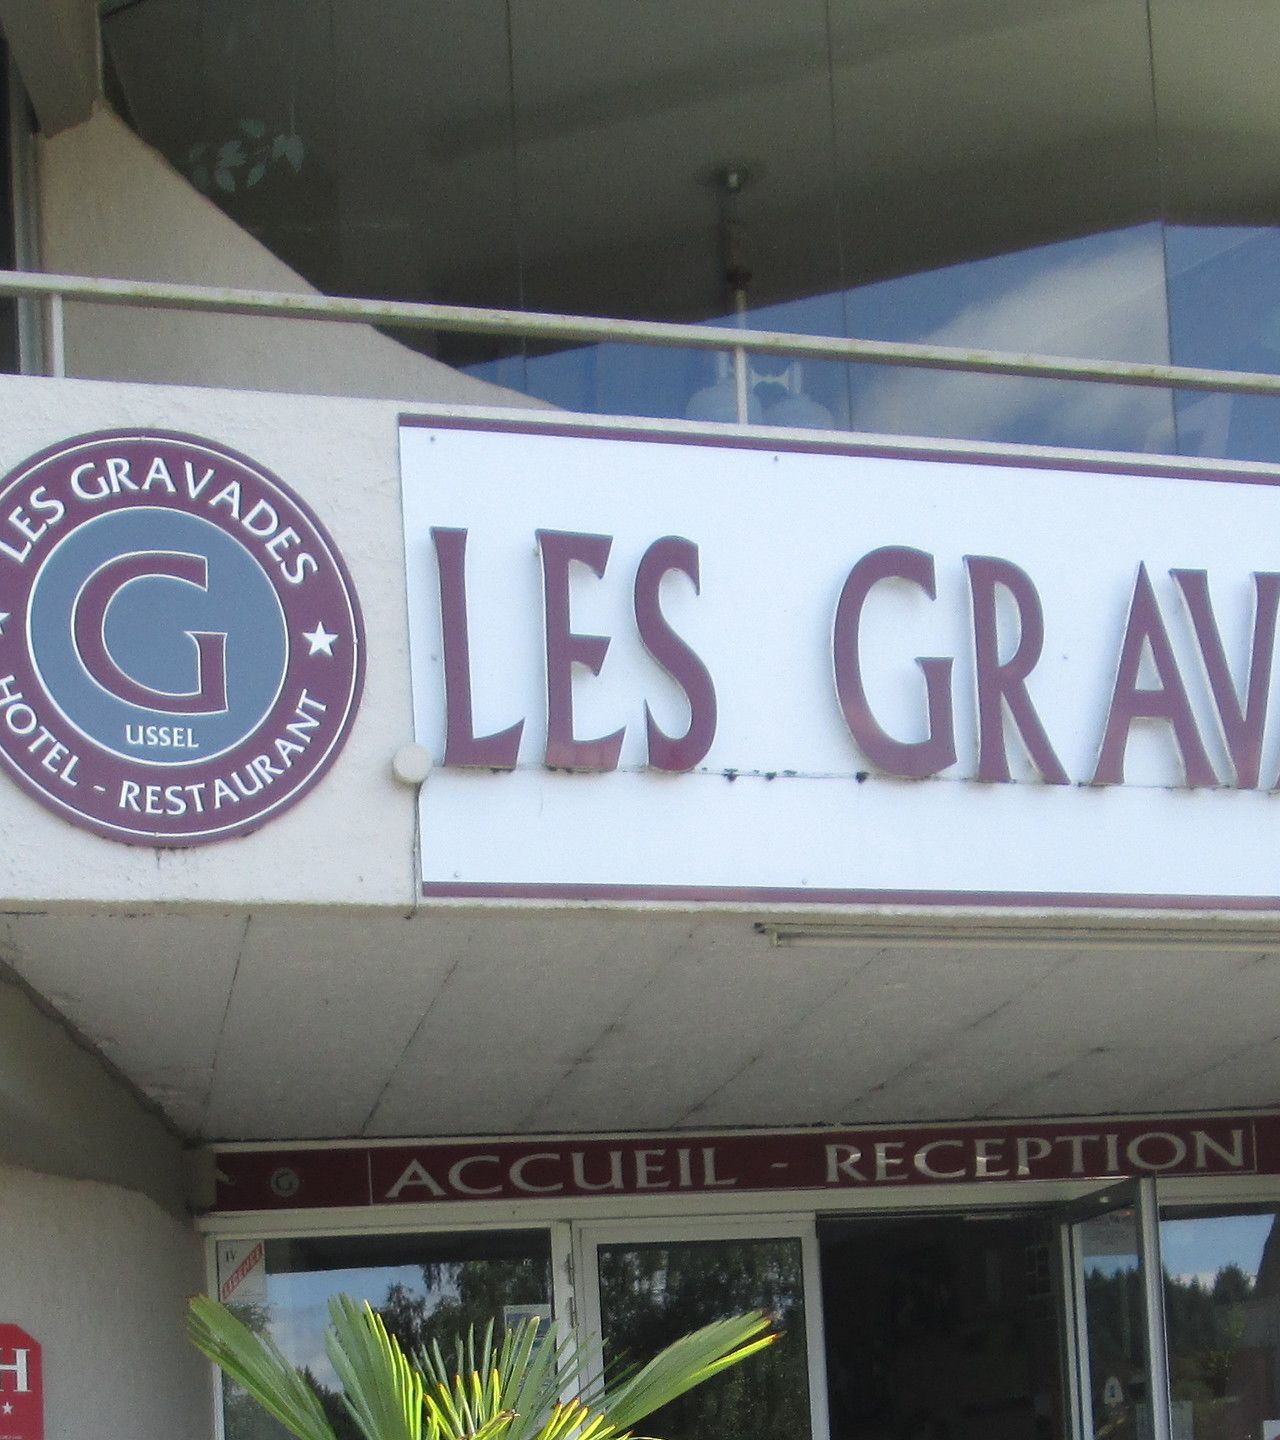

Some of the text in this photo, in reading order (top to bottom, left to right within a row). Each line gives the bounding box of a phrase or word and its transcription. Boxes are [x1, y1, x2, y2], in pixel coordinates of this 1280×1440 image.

[71, 457, 318, 585] GRAVADES
[71, 550, 229, 716] G
[431, 527, 718, 772] LES
[118, 688, 329, 816] RESTAURANT
[125, 724, 199, 748] USSEL
[385, 1147, 737, 1199] ACCUEIL
[825, 1129, 1244, 1183] RECEPTION
